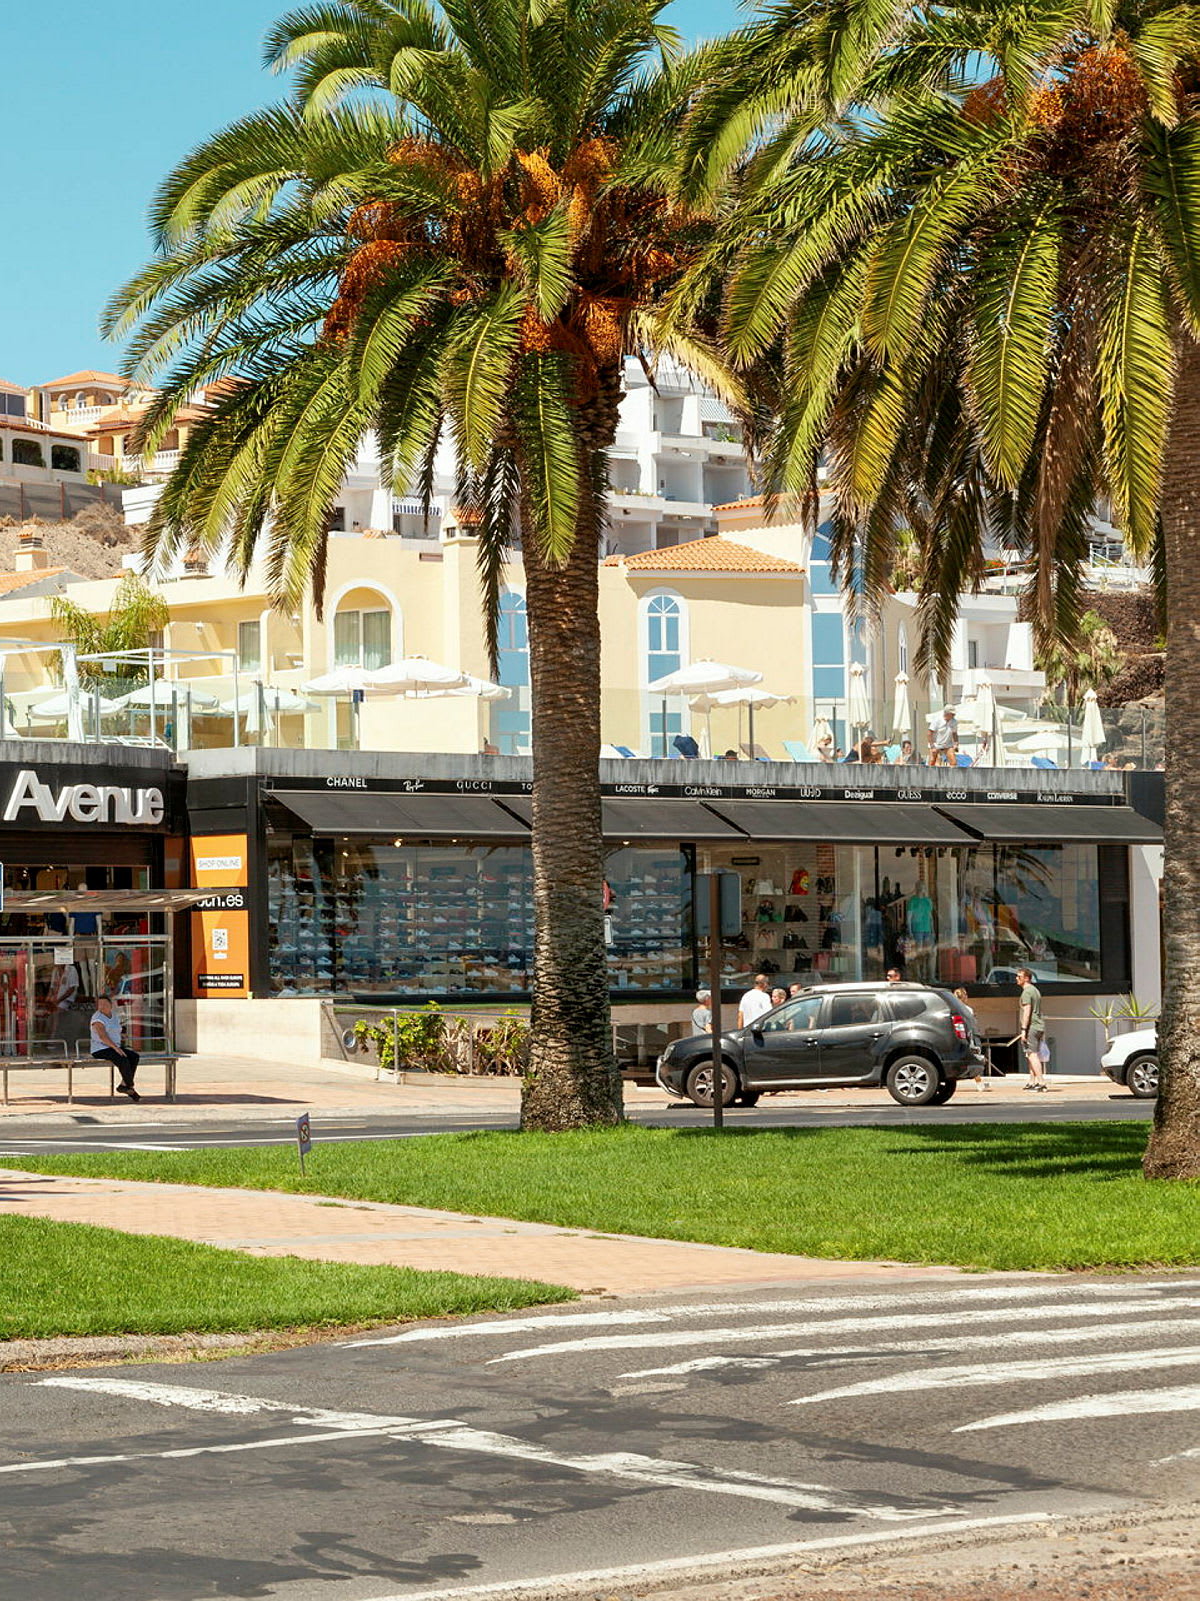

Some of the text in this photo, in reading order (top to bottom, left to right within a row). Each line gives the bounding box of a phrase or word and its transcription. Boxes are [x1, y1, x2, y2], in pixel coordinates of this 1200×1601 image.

[326, 777, 368, 788] CHANEL
[456, 781, 492, 790] GUCCI
[615, 785, 645, 794] LACOSTE
[746, 788, 776, 796] MORGAN
[2, 769, 165, 826] Avenue
[897, 790, 922, 800] GUESS
